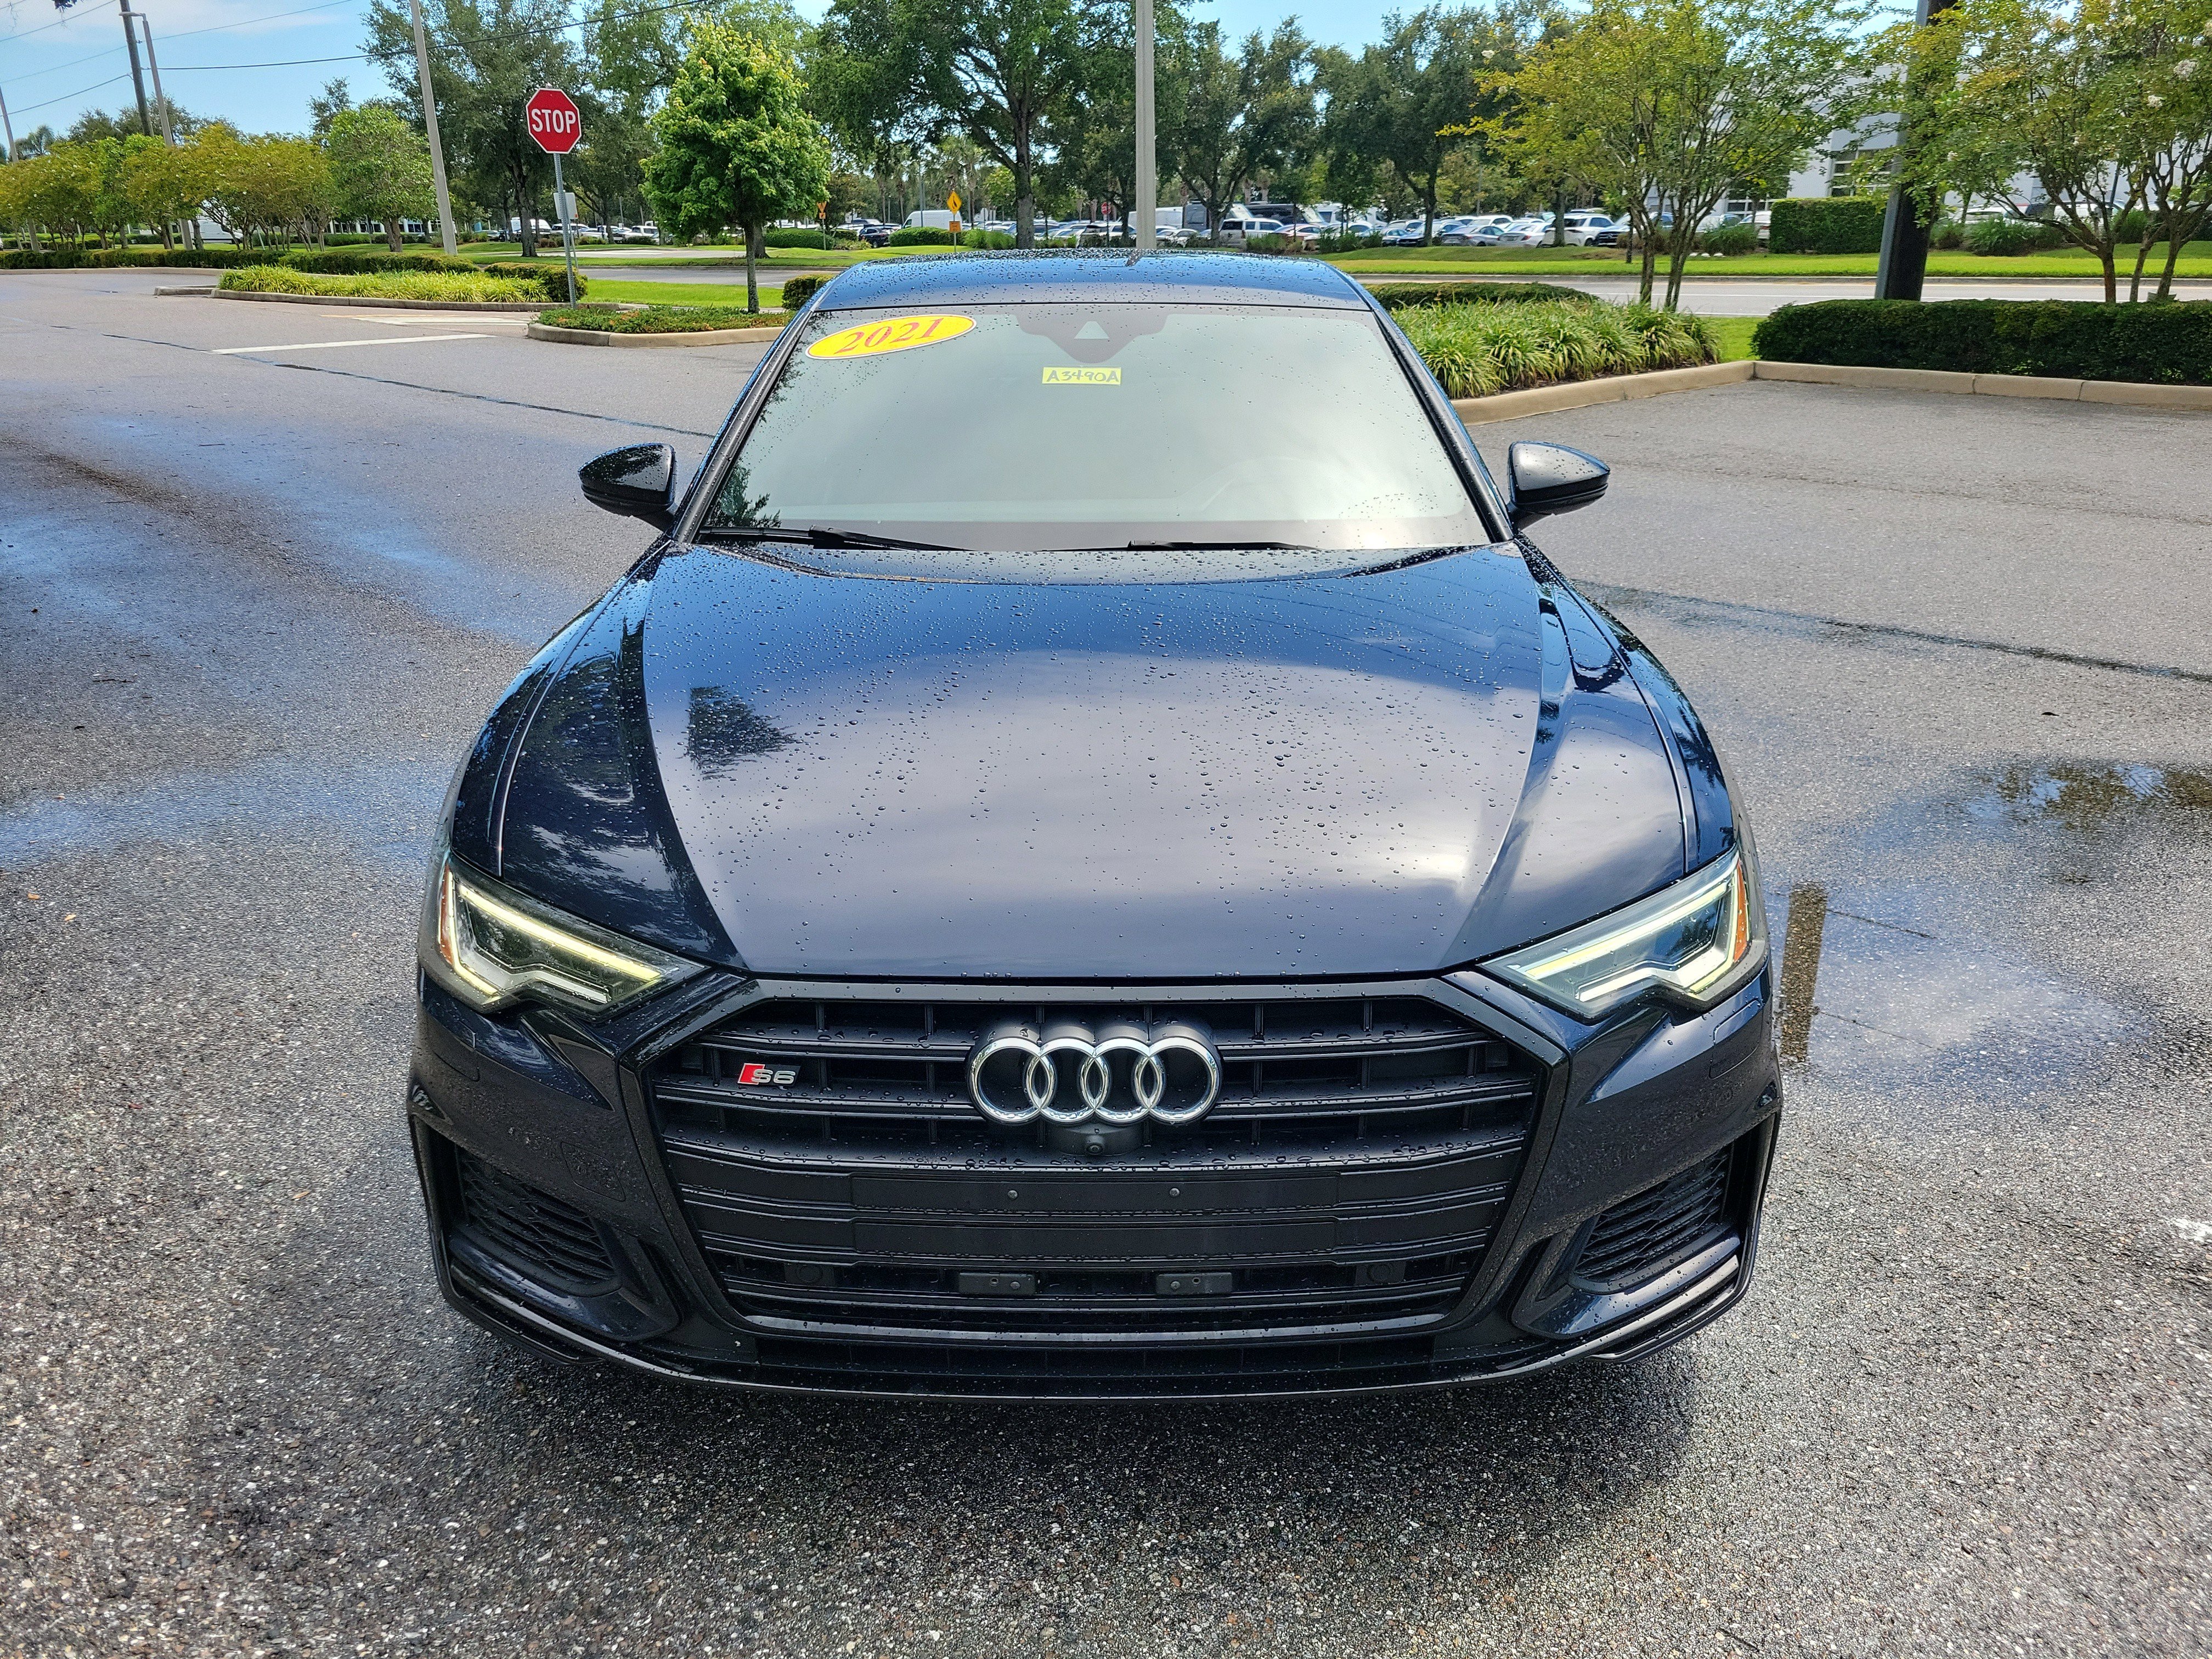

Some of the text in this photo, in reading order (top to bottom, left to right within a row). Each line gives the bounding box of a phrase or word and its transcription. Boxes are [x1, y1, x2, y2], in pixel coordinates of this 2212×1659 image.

[531, 108, 576, 133] STOP
[833, 318, 944, 355] 2021
[1046, 369, 1119, 382] A3490A
[751, 1069, 796, 1084] S6
